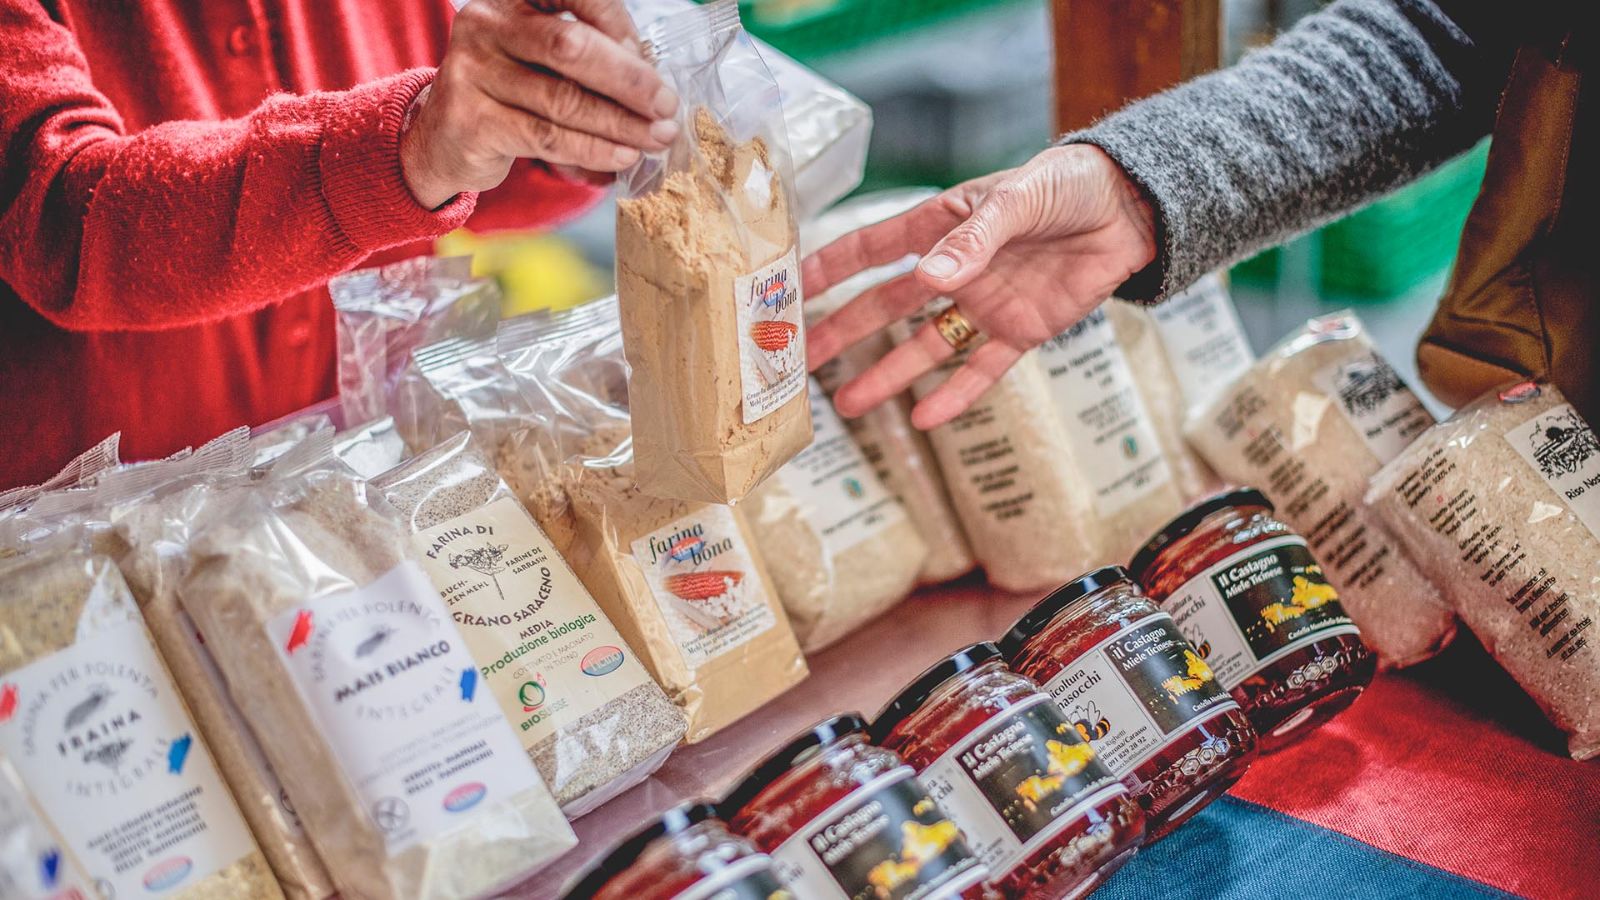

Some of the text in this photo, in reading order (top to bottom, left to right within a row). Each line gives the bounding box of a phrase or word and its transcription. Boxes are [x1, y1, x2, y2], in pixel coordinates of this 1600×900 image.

[747, 268, 787, 306] farina
[775, 287, 797, 314] bona
[1565, 486, 1585, 500] Riso
[426, 524, 494, 560] FARINA DI
[649, 522, 704, 564] farina
[690, 537, 733, 566] bona
[505, 546, 542, 568] FARINE DE
[512, 555, 547, 575] SARRASIN
[1229, 554, 1278, 582] Castagno
[440, 579, 467, 598] BUCH-
[448, 581, 489, 606] ZENMEHL
[452, 567, 551, 627] GRANO SARACENO
[1225, 566, 1283, 599] Miele Ticinese
[519, 619, 554, 640] MEDIA
[1576, 616, 1591, 629] frais
[481, 634, 549, 680] Produzione
[549, 613, 596, 639] biologica
[1124, 627, 1166, 653] Castagno
[513, 652, 553, 680] COLTIVATO
[558, 633, 594, 655] MACINATO
[544, 663, 553, 673] IN
[554, 651, 578, 670] TICINO
[1122, 639, 1174, 671] Miele Ticinese
[334, 639, 451, 703] MAIS BIANCO
[1058, 670, 1101, 710] nasocchi
[973, 721, 1026, 759] Castagno
[1105, 730, 1126, 747] Righetti
[1108, 736, 1146, 768] 091 829 28 92
